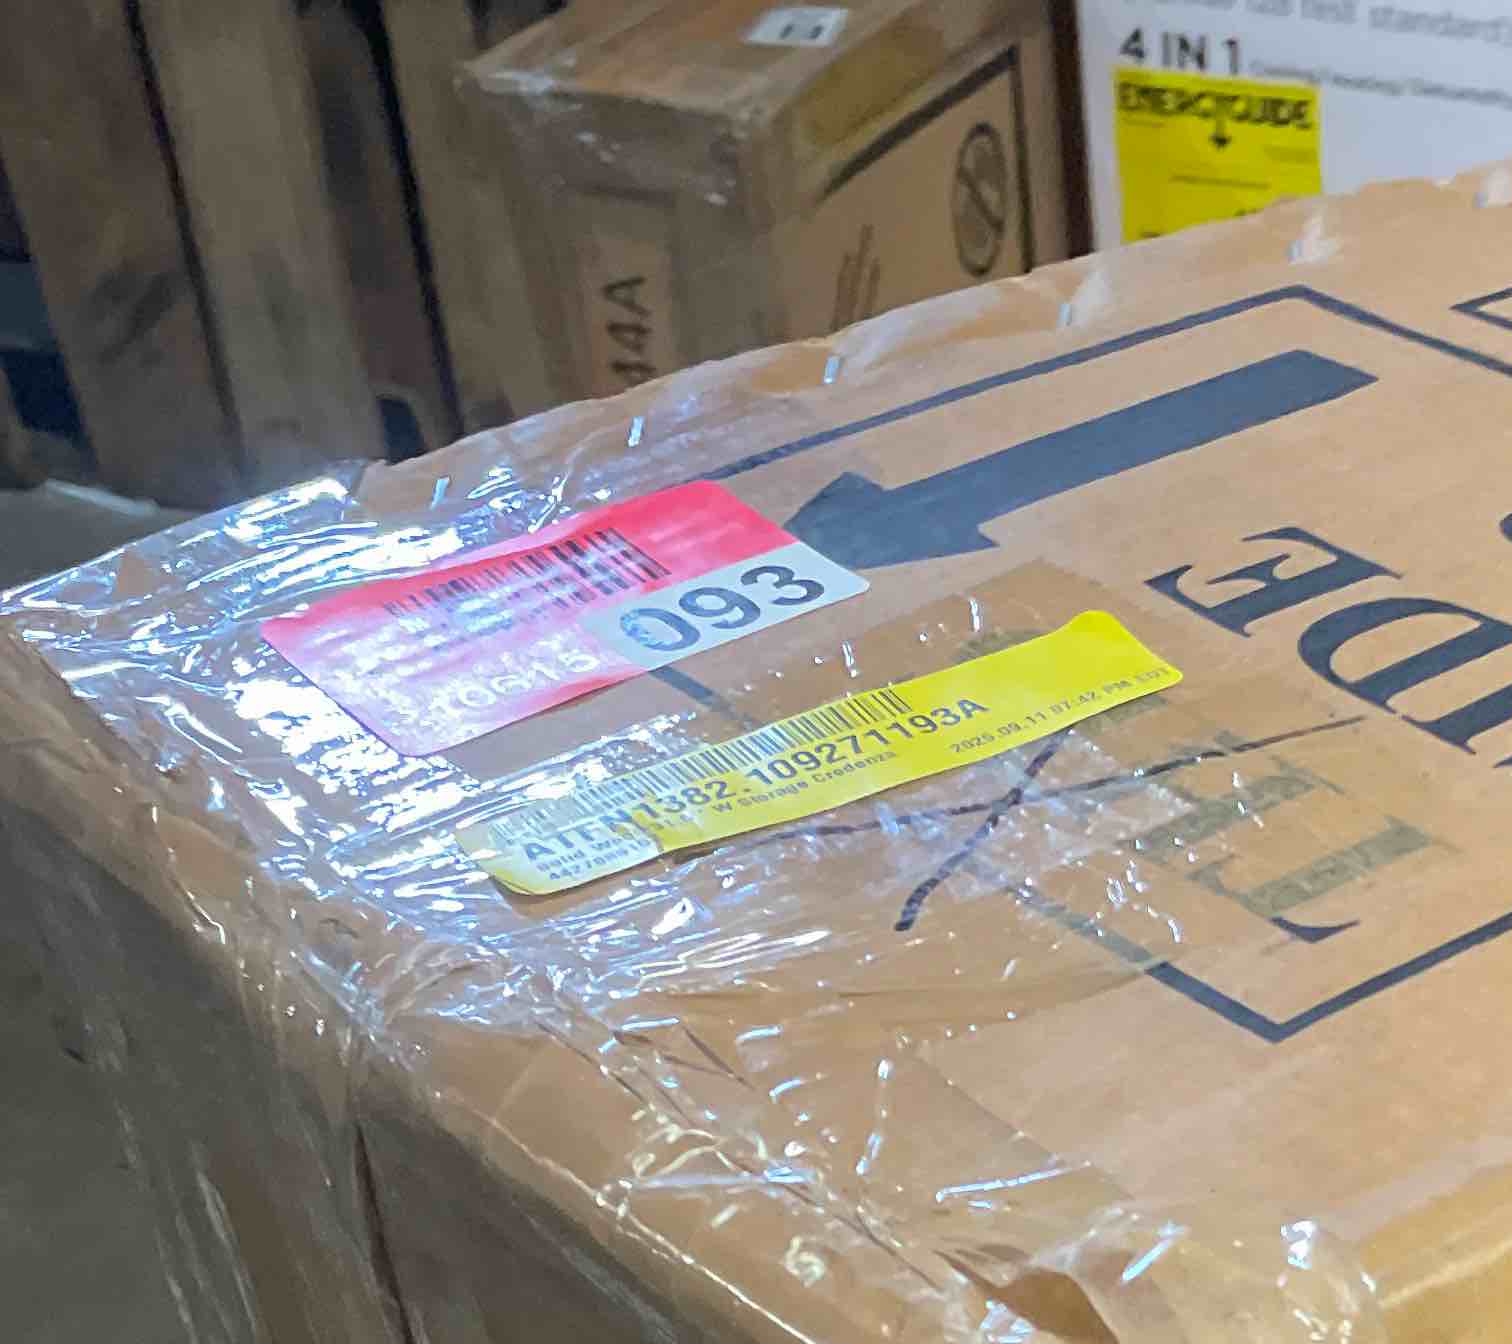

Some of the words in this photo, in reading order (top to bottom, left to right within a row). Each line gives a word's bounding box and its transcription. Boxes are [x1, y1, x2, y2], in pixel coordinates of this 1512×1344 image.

[1120, 27, 1146, 66] 4
[1161, 31, 1207, 71] IN
[1222, 37, 1240, 76] 1
[618, 564, 826, 652] 093
